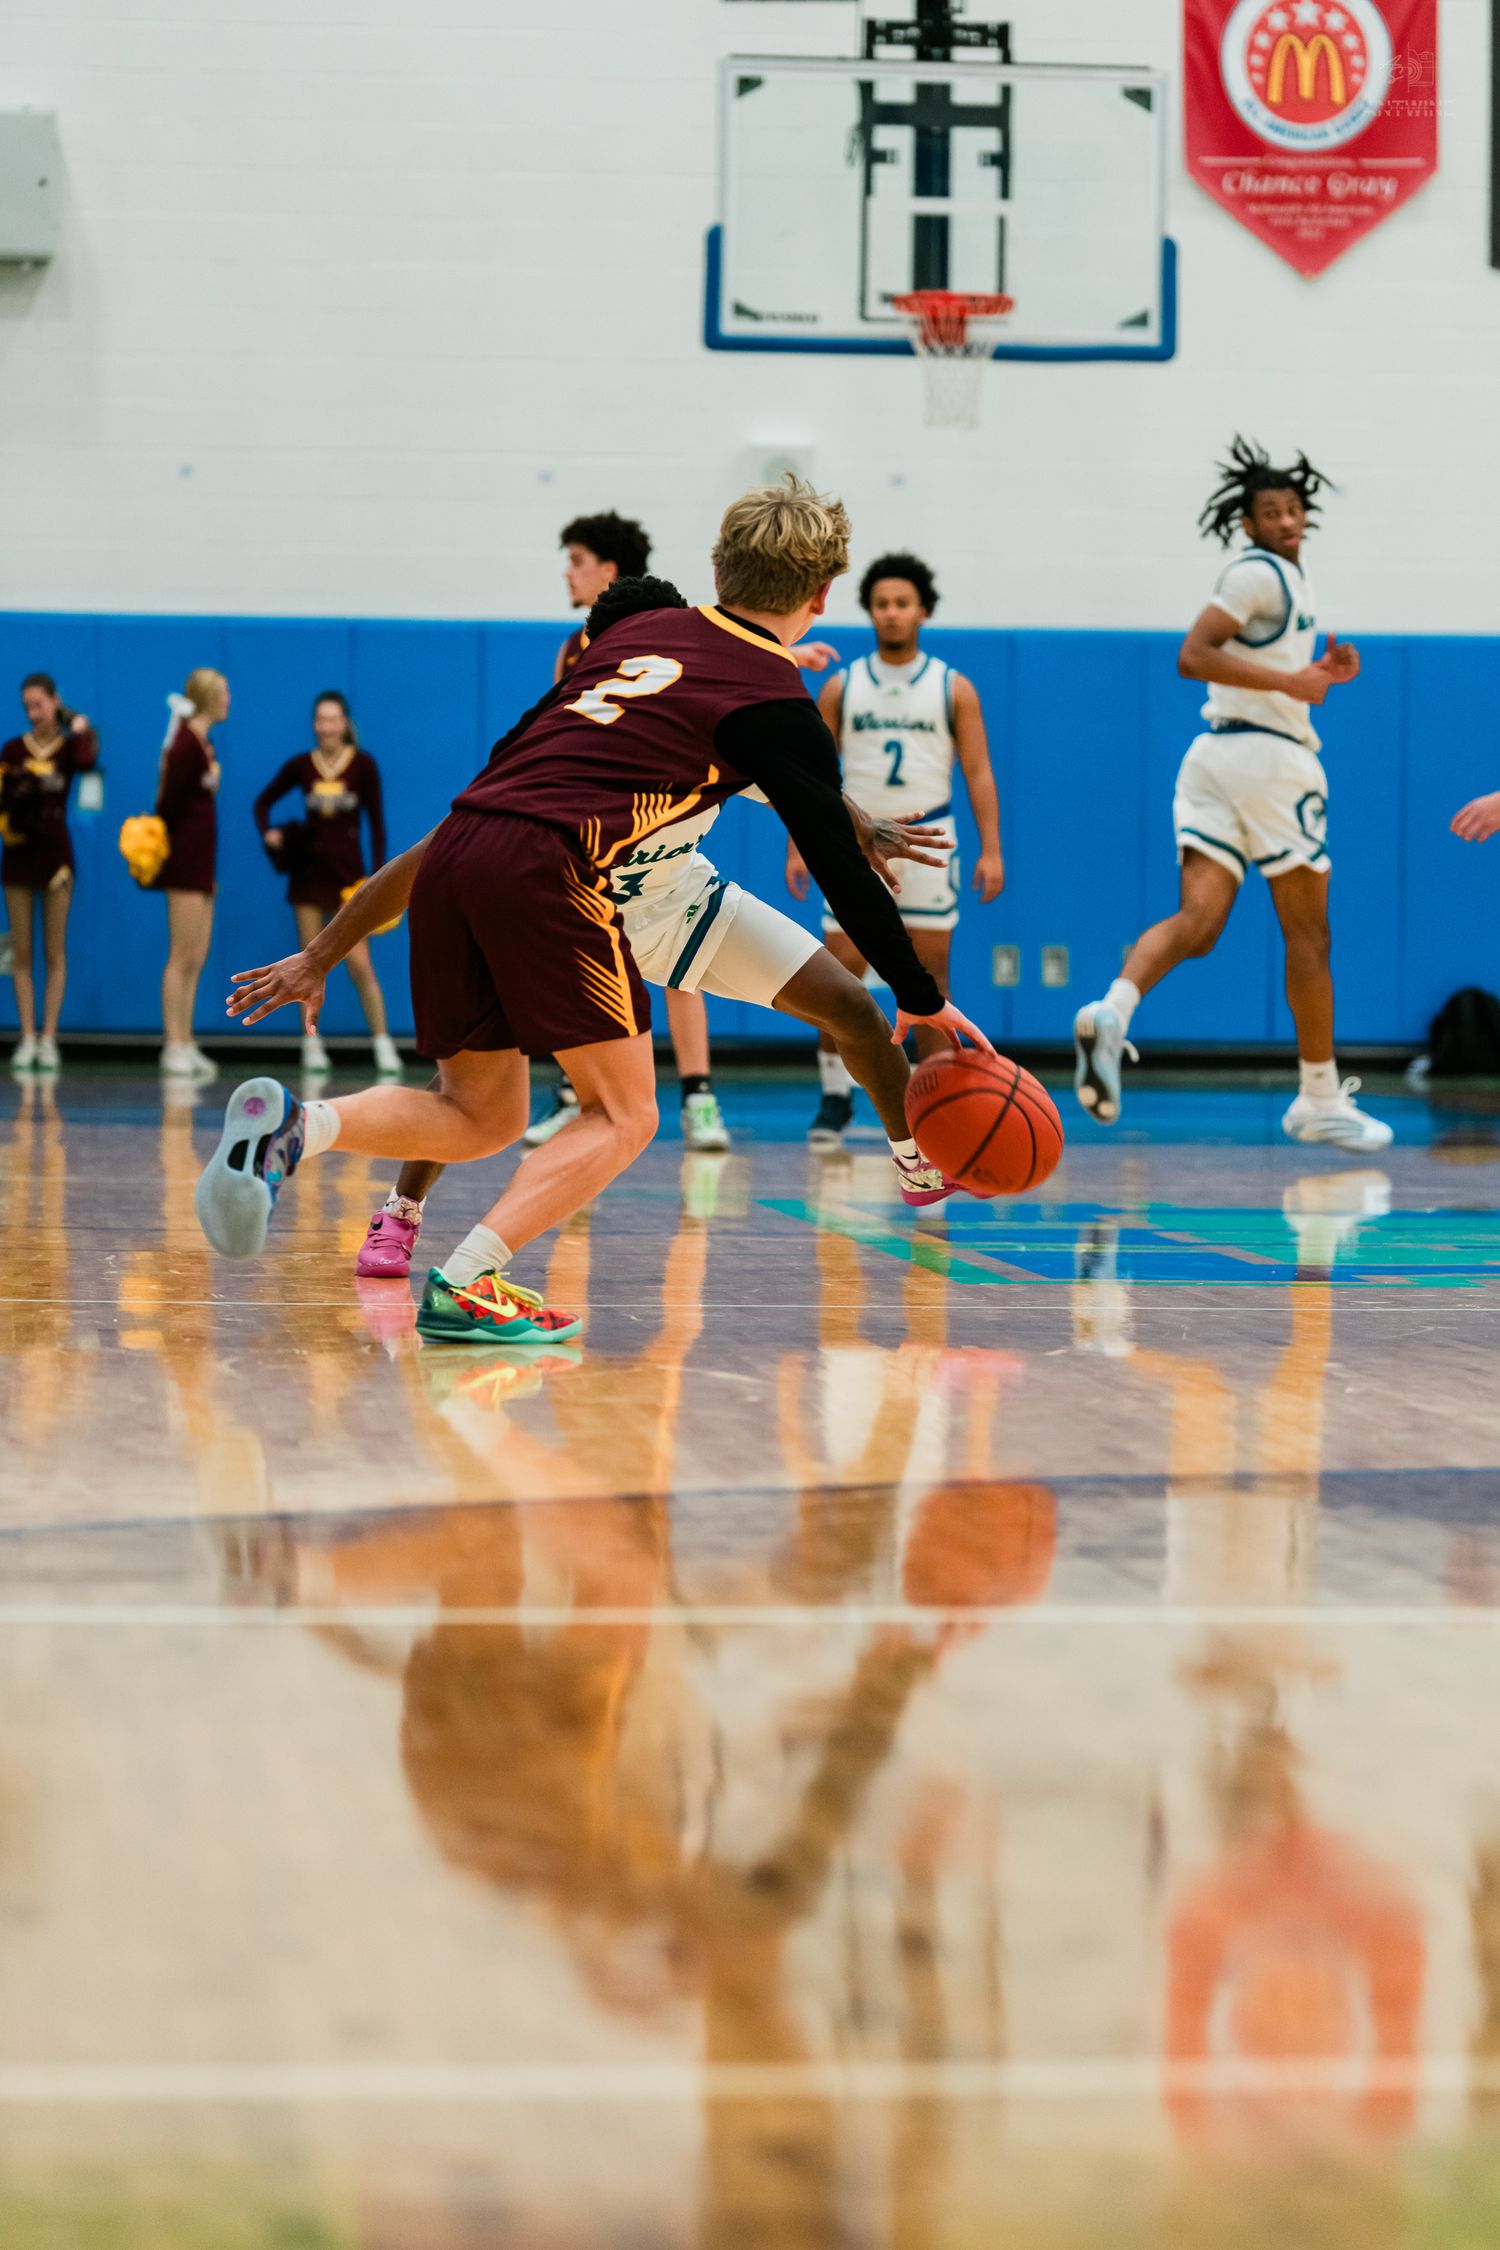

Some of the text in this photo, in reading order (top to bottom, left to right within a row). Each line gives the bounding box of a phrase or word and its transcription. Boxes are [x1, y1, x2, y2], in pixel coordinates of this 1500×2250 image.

[563, 654, 683, 725] 2
[884, 740, 904, 786] 2
[611, 868, 653, 905] 3
